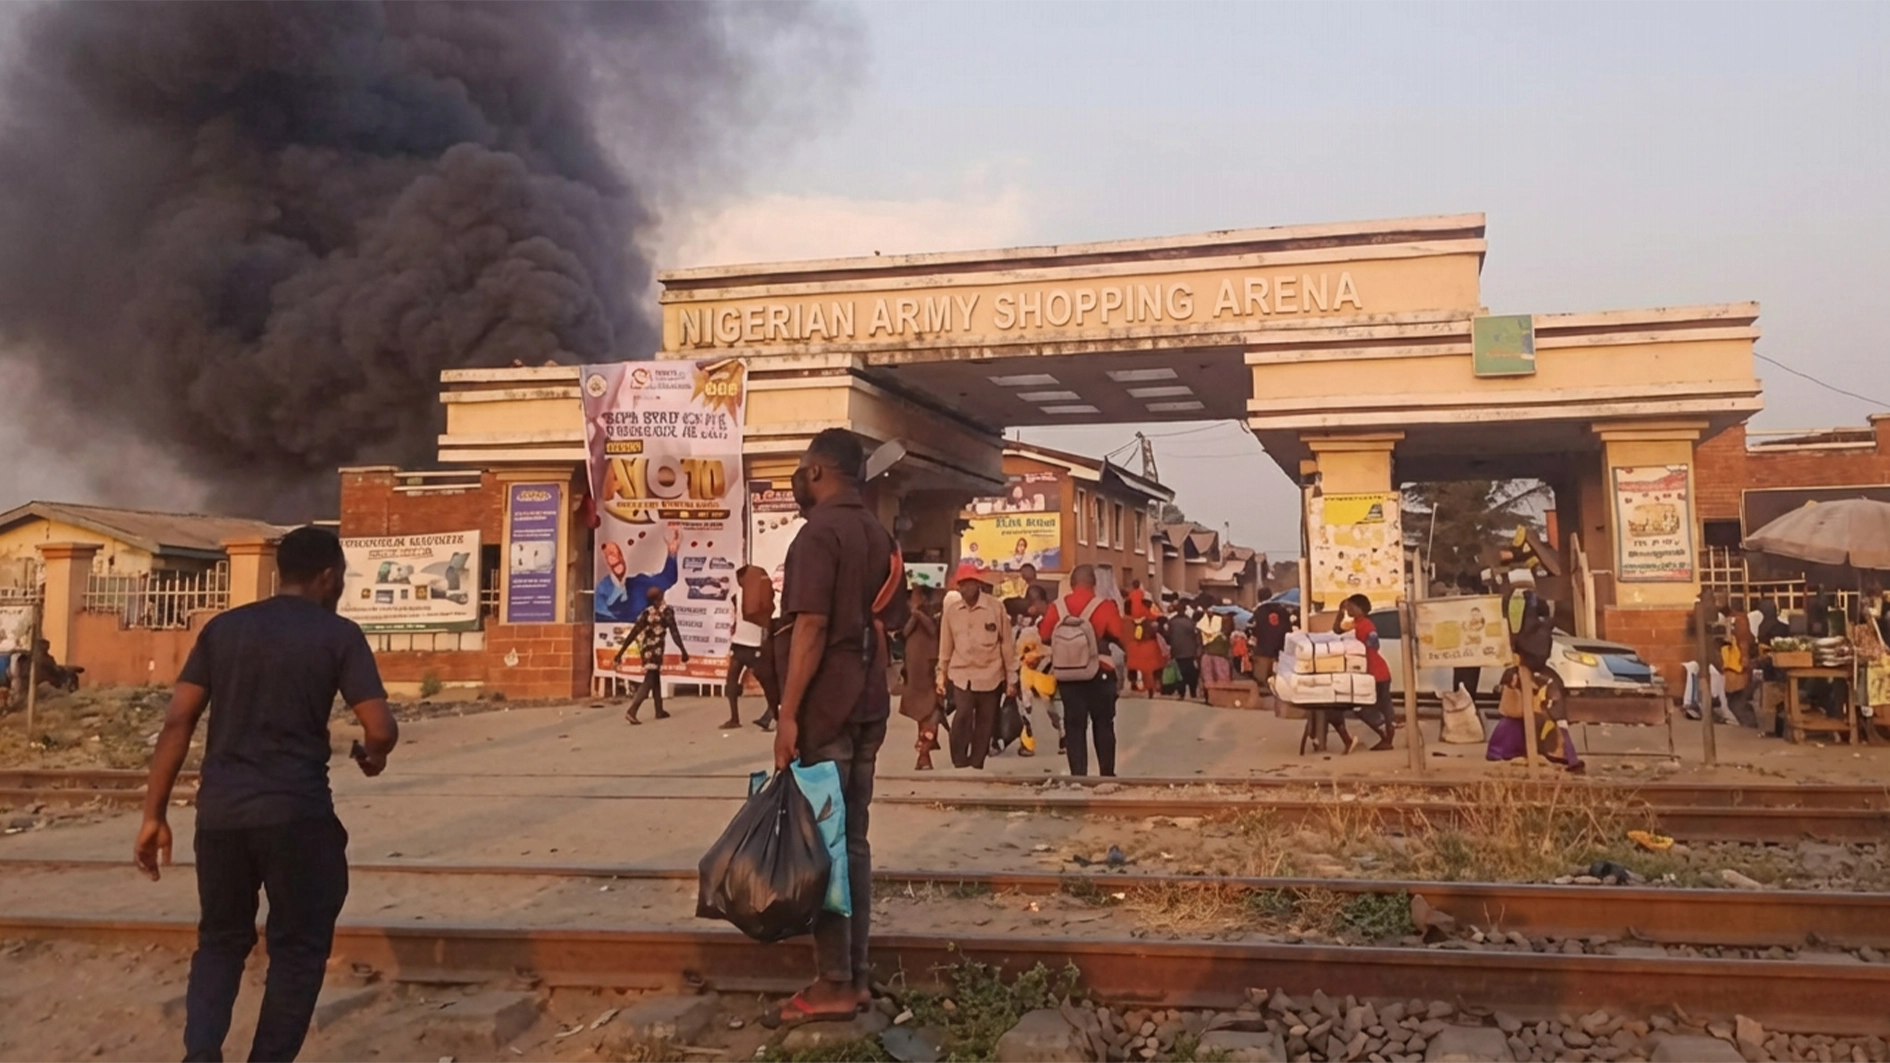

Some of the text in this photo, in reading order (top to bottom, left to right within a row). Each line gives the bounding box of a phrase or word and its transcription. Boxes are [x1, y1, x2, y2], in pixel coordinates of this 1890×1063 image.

[679, 271, 1363, 346] NIGERIAN ARMY SHOPPING ARENA
